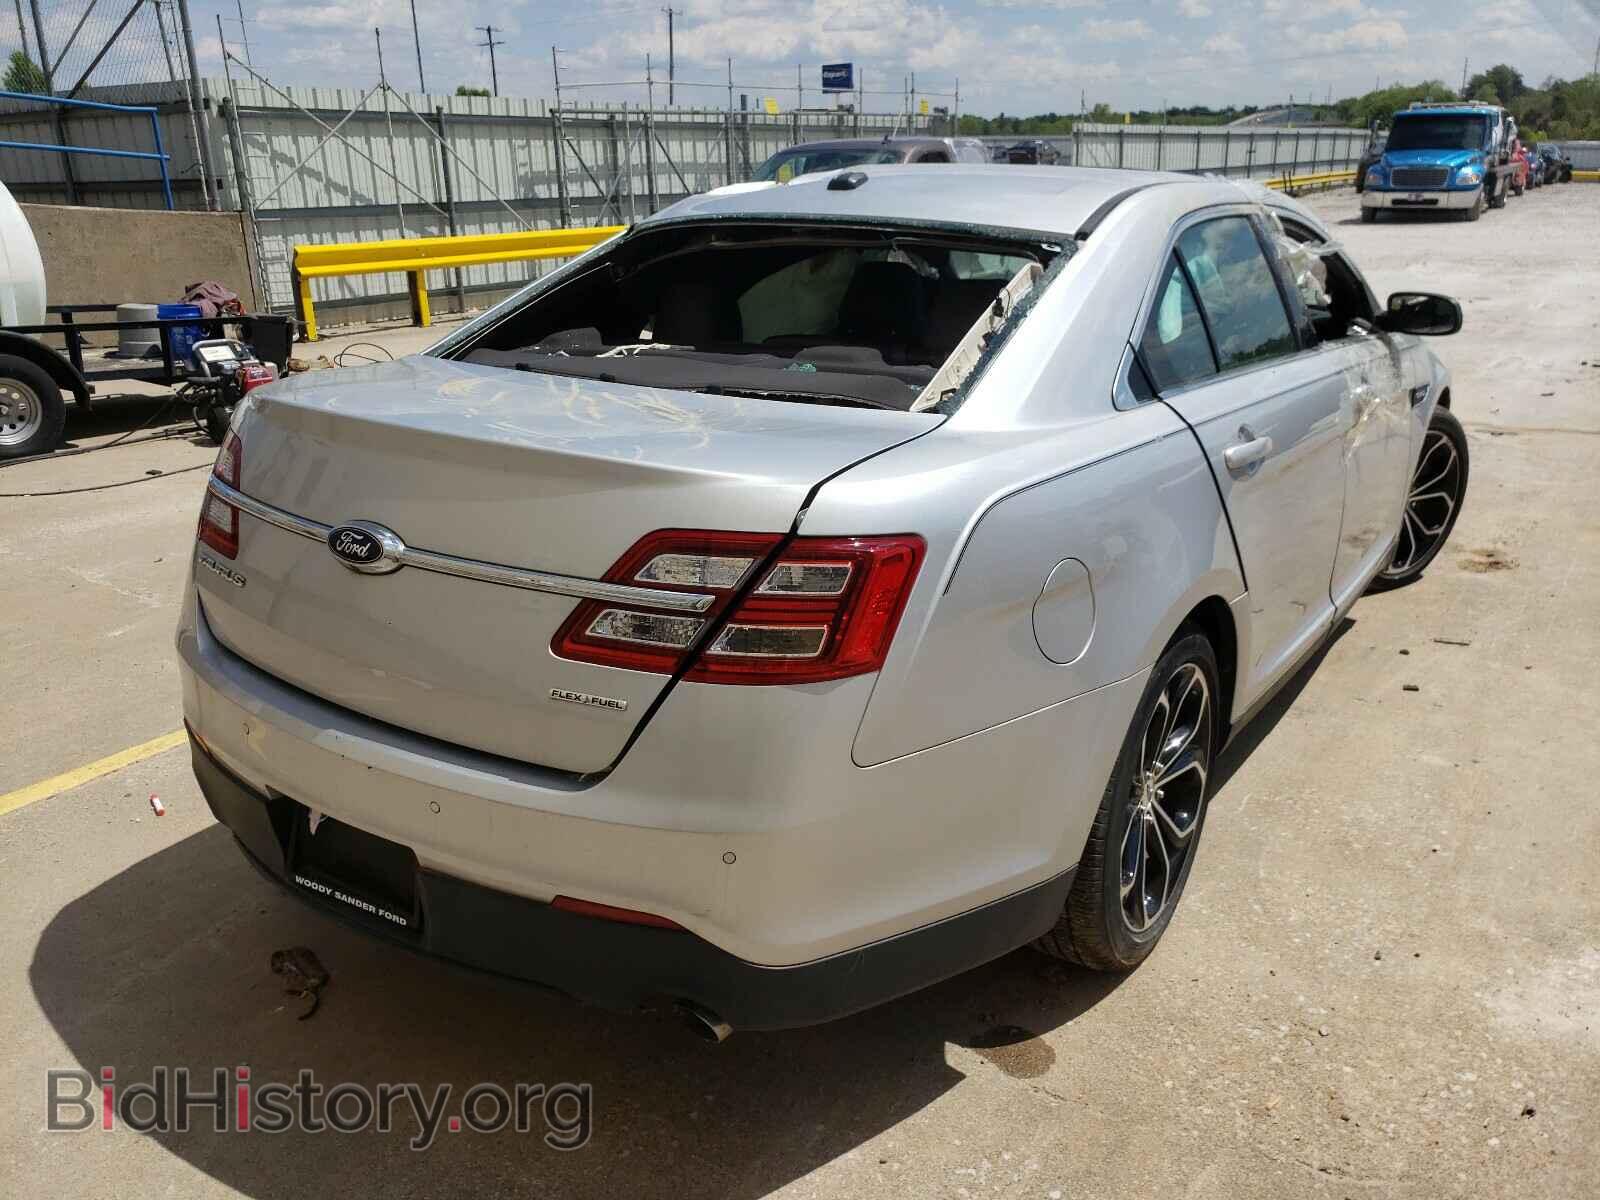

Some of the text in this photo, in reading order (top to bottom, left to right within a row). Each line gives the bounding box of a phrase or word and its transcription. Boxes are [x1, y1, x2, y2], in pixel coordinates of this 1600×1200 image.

[336, 530, 371, 558] Ford
[551, 689, 623, 709] FLEX FUEL
[295, 875, 408, 926] WOODY SANDER FORD
